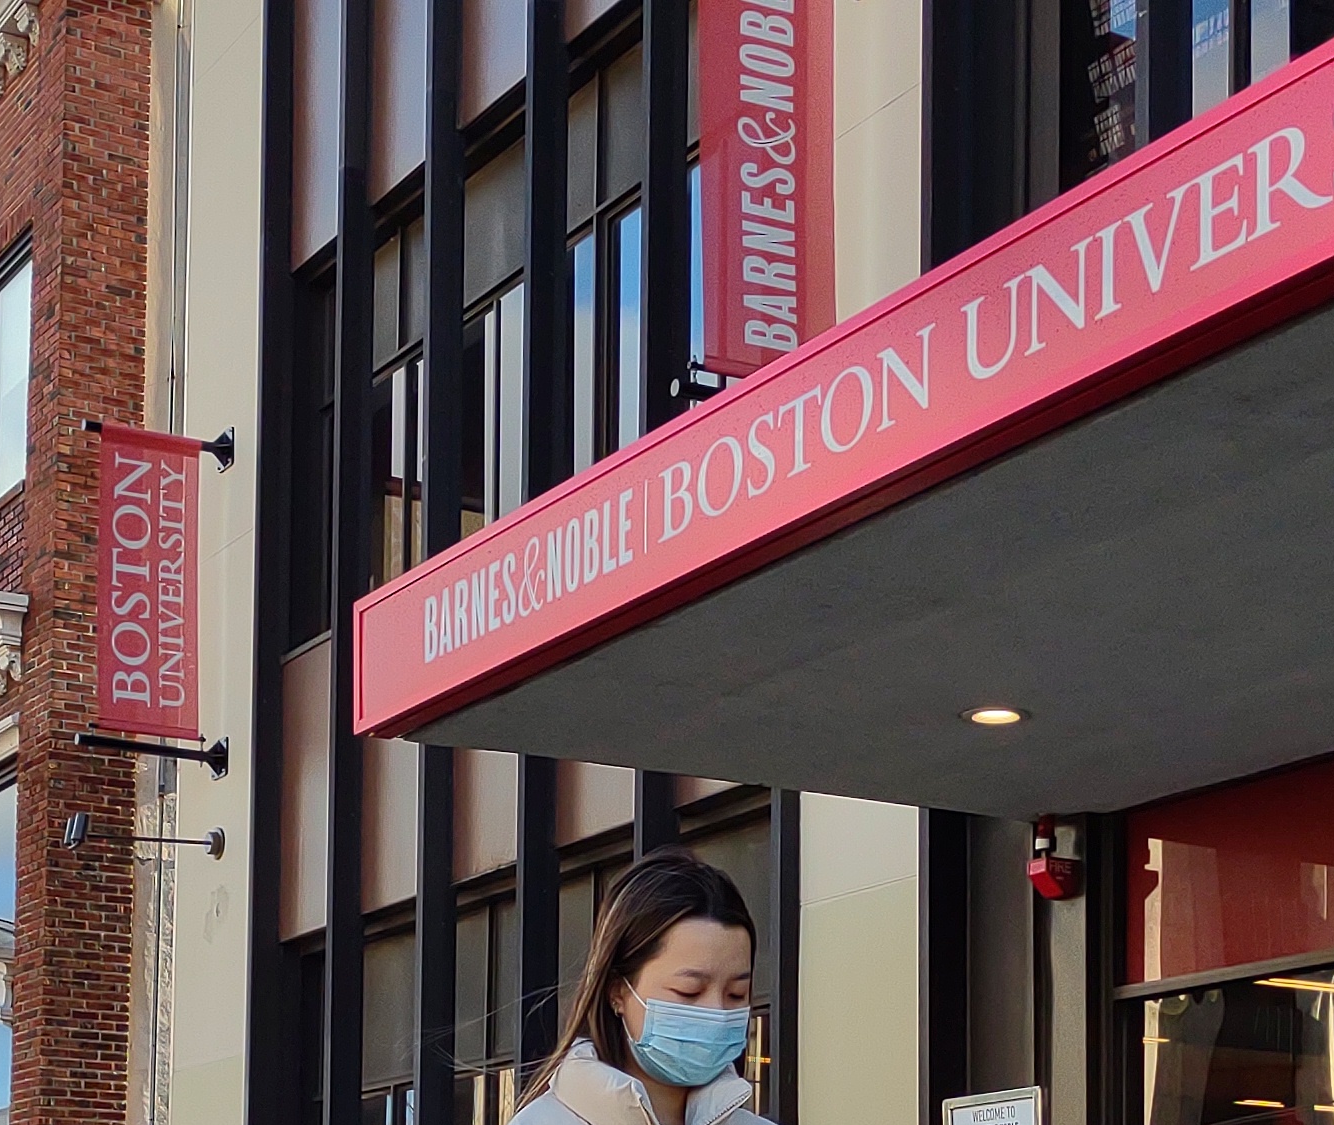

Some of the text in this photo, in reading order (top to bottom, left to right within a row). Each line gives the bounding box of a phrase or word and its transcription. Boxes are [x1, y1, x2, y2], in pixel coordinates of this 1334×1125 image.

[657, 324, 936, 543] BOSTON
[111, 452, 153, 708] BOSTON
[158, 459, 186, 708] UNIVERSITY
[1049, 860, 1072, 874] FIRE
[972, 1105, 1016, 1123] WELCOME TO
